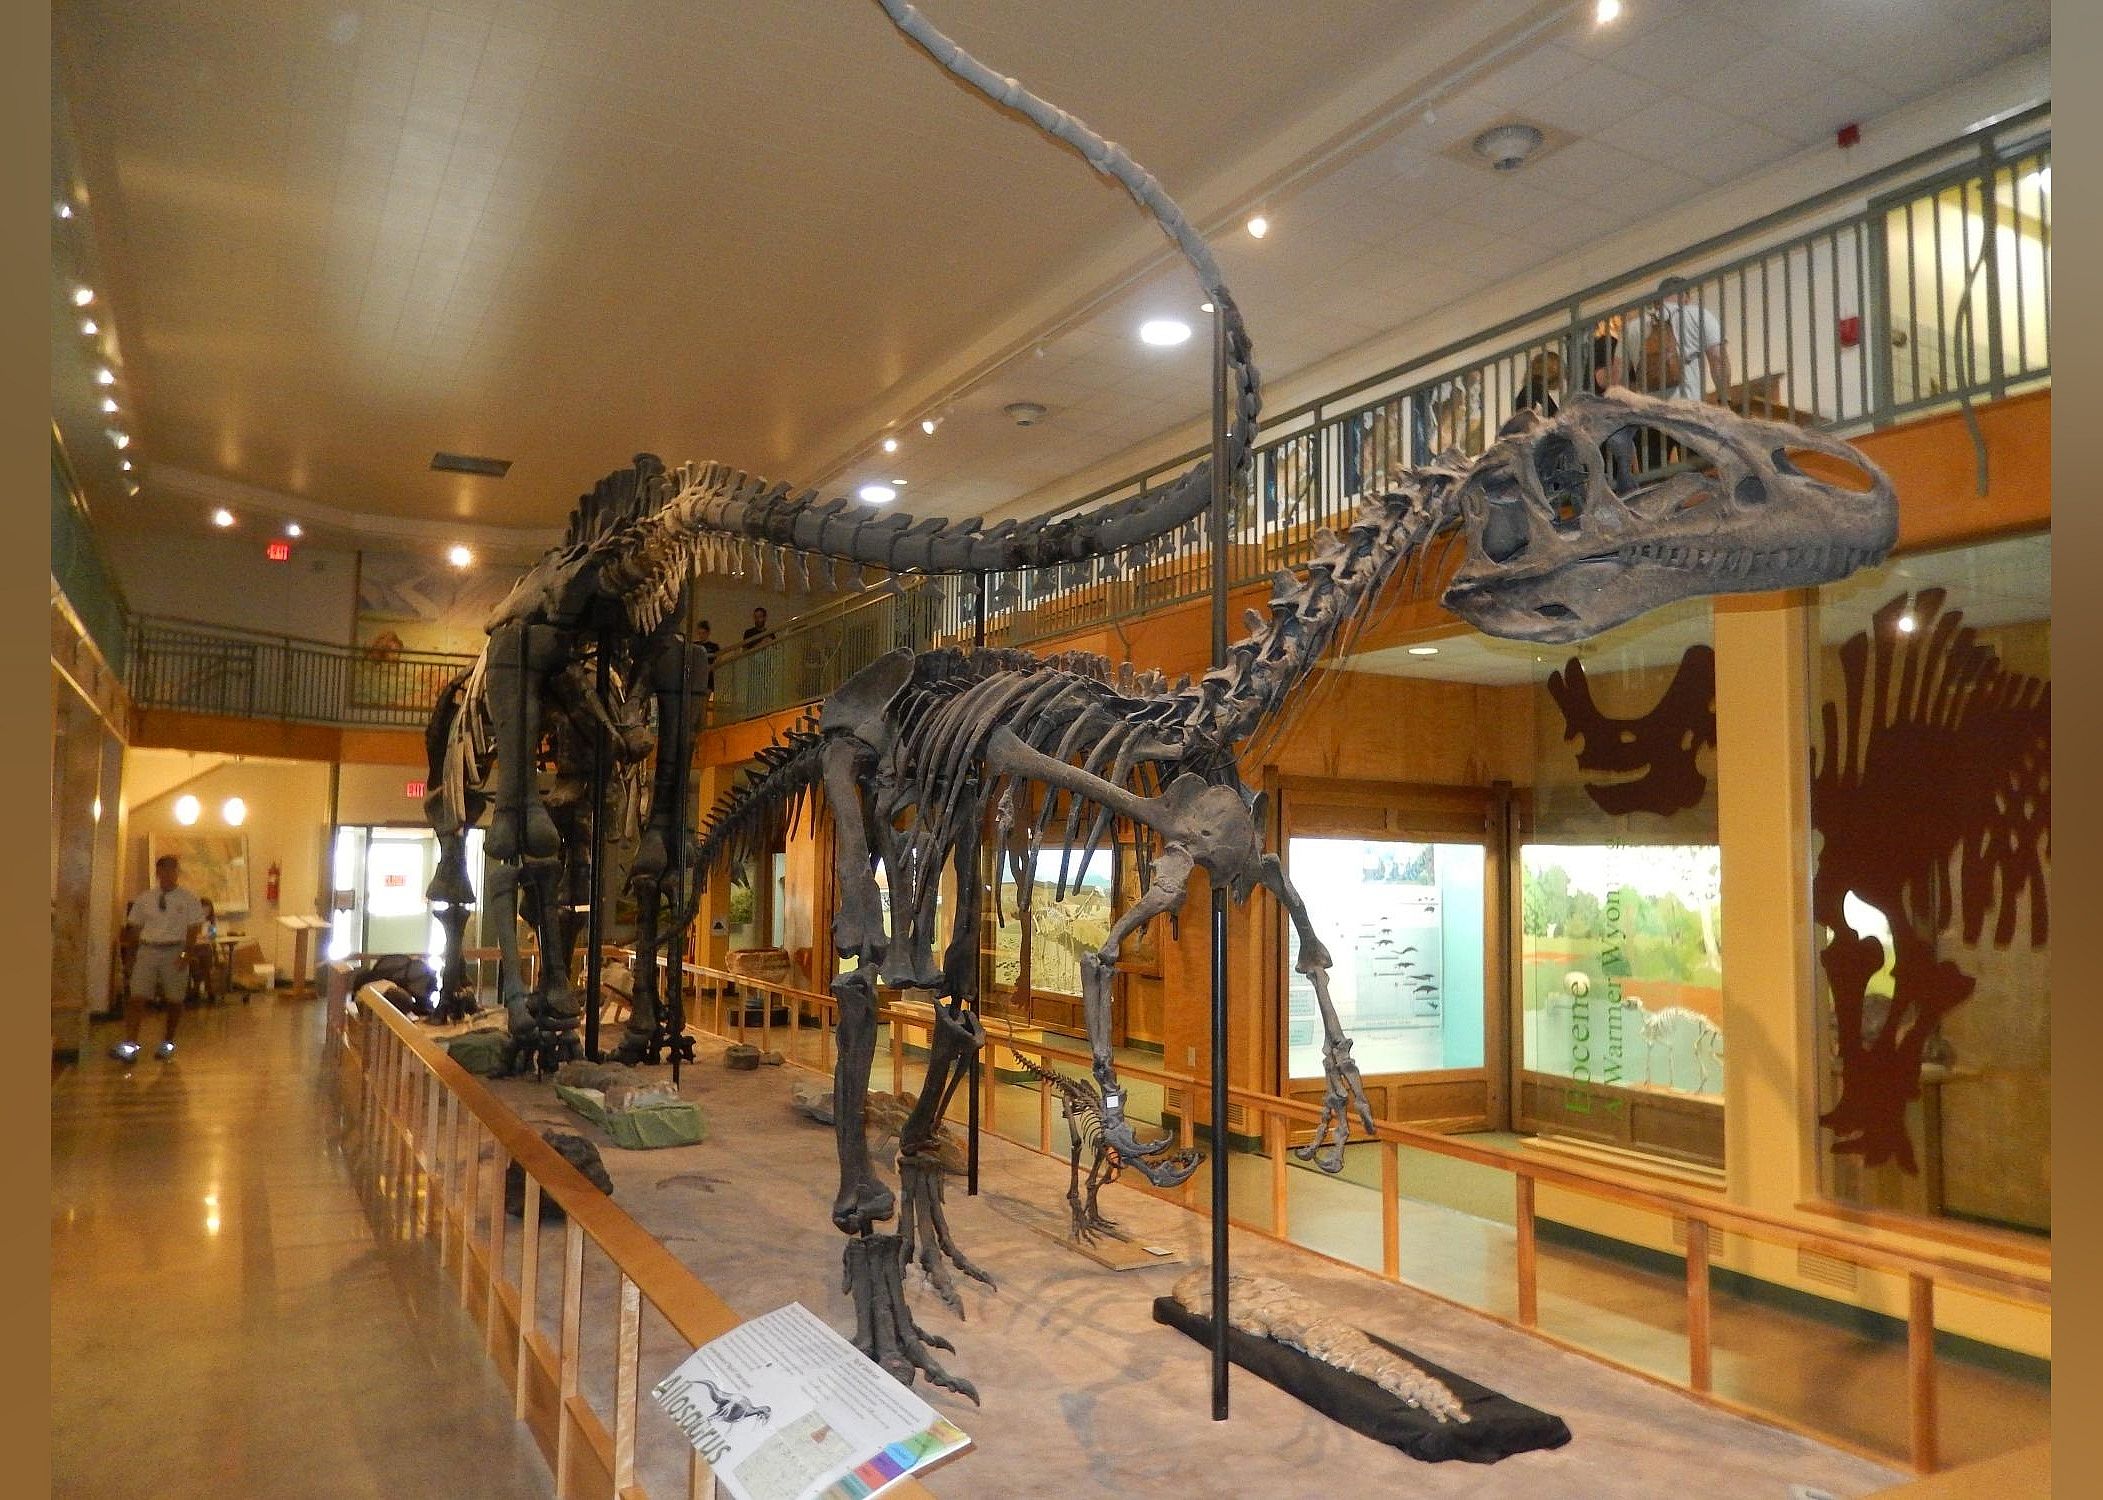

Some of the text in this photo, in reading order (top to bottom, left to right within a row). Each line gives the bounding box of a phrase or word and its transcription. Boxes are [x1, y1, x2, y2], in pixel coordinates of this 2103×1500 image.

[407, 783, 425, 797] EXIT
[1564, 981, 1591, 1114] Eocene
[1603, 977, 1623, 1086] Warmer
[653, 1375, 731, 1464] Allosaurus
